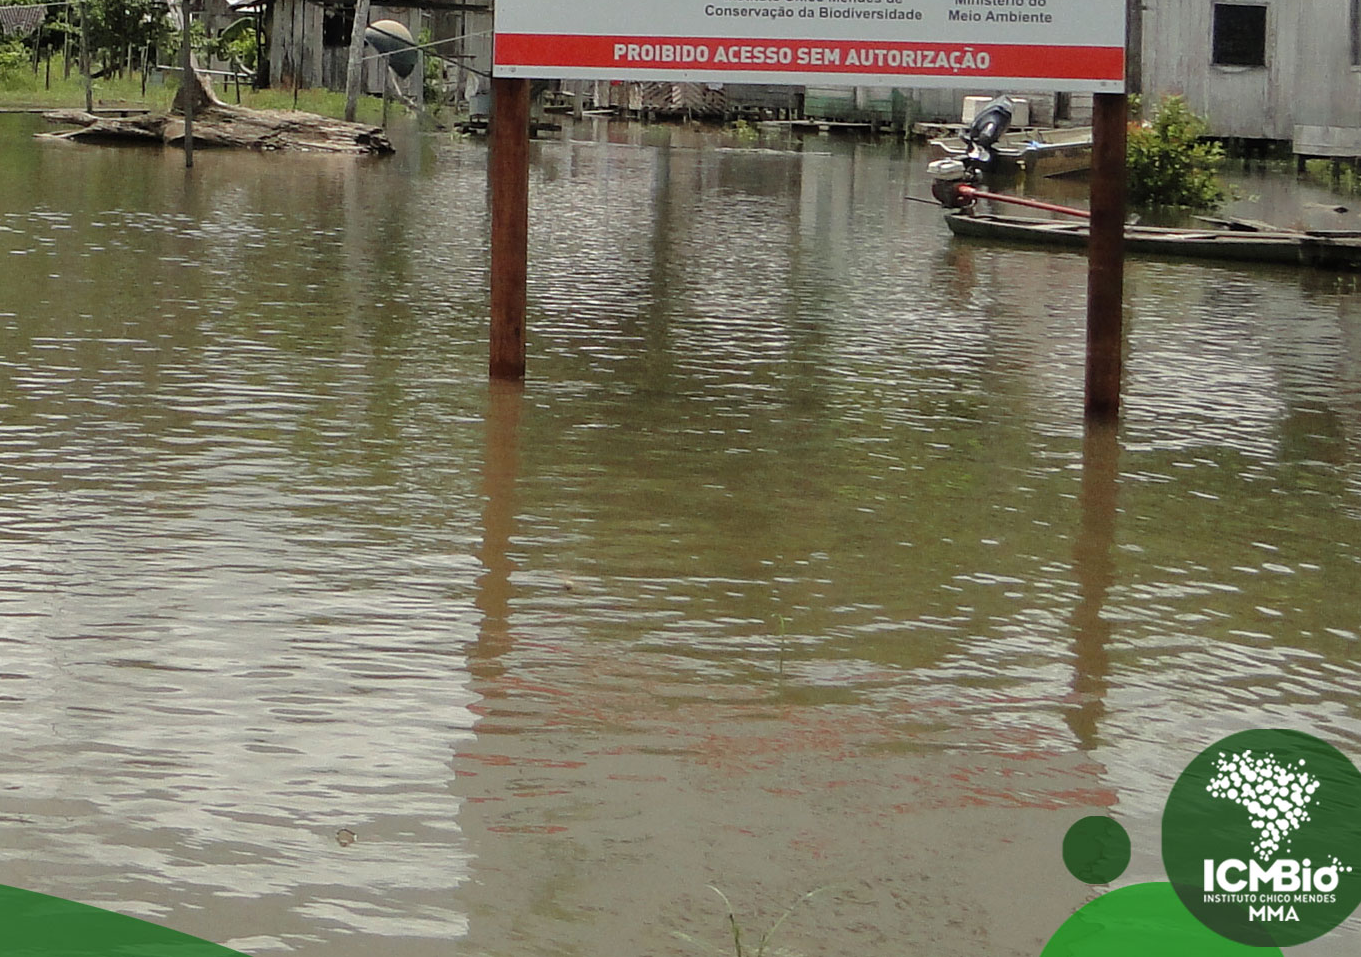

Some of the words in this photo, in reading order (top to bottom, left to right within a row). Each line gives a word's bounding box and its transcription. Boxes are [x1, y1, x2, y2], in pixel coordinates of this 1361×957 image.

[704, 4, 794, 19] Conservação
[798, 6, 815, 18] da
[819, 6, 923, 21] Biodiversidade
[948, 9, 982, 22] Meio
[985, 10, 1053, 23] Ambiente
[613, 43, 709, 63] PROIBIDO
[713, 46, 793, 64] ACESSO
[796, 47, 841, 66] SEM
[844, 47, 991, 73] AUTORIZAÇÃO
